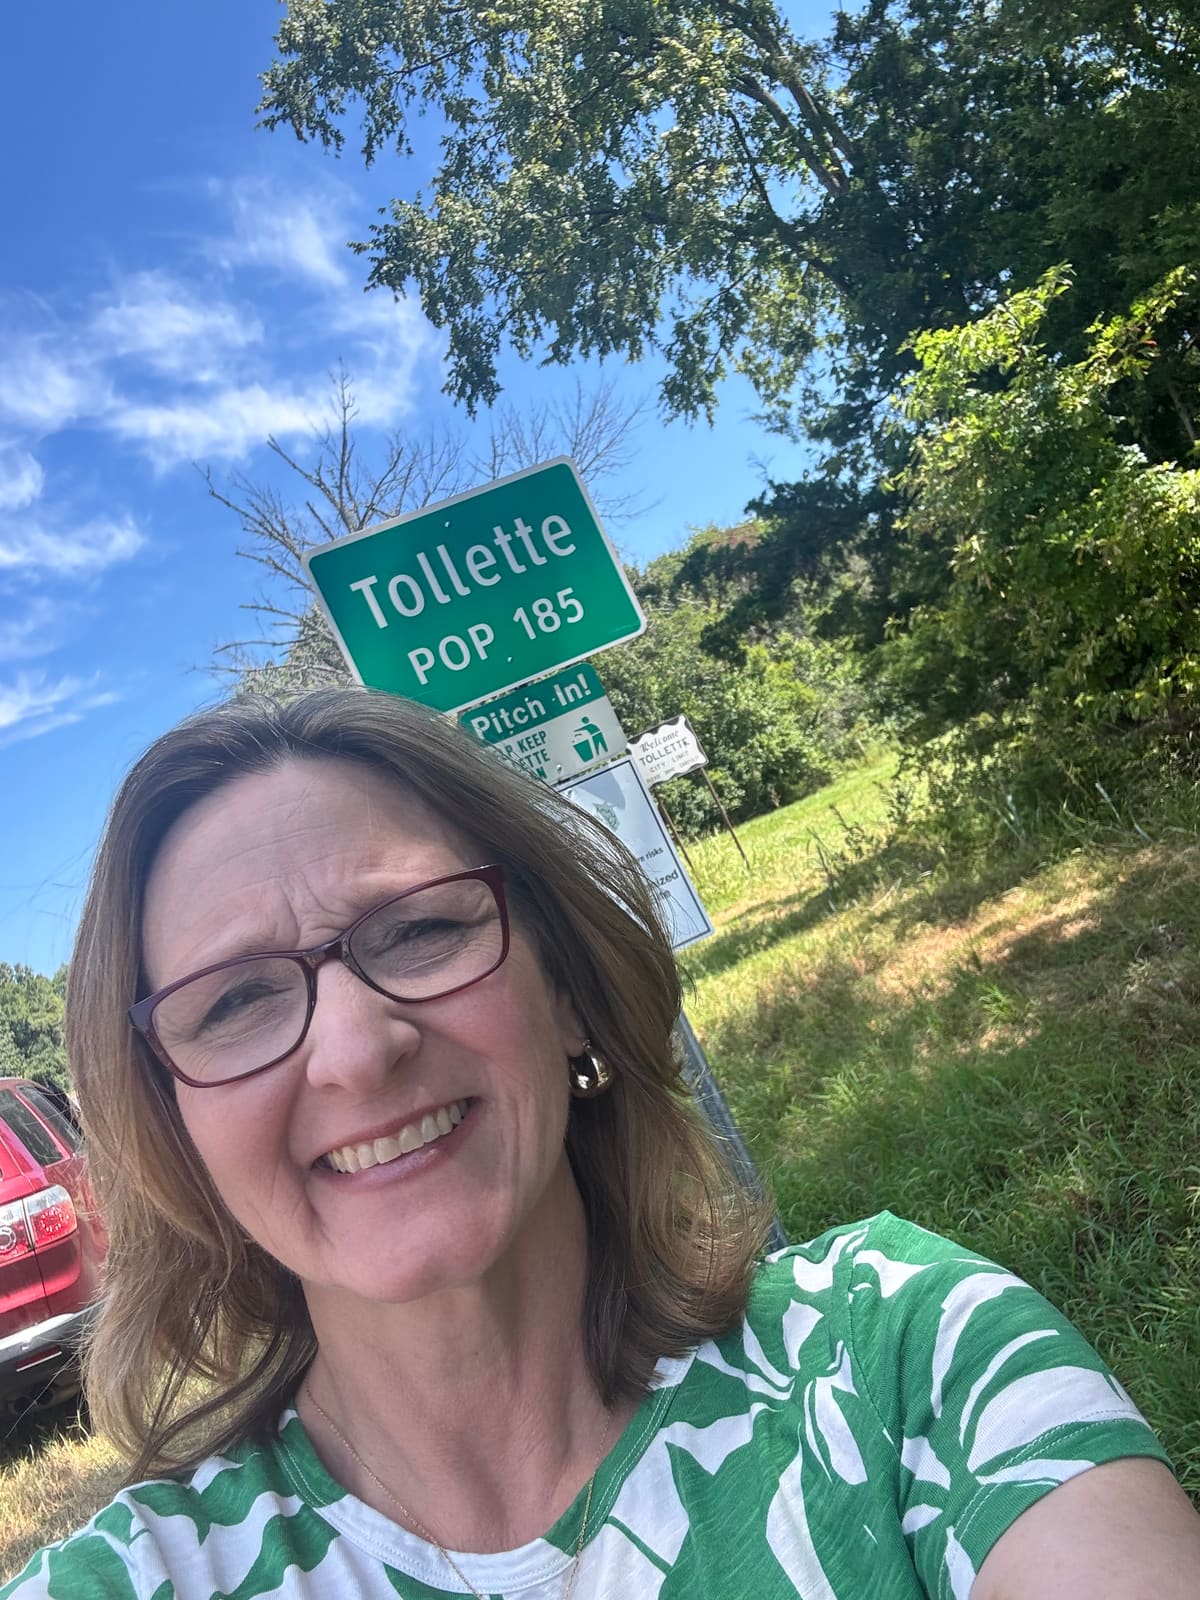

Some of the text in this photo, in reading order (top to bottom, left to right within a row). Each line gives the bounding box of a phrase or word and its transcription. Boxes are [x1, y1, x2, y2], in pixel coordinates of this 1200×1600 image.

[350, 514, 577, 629] Tollette
[407, 587, 585, 685] POP 185
[471, 673, 592, 740] Pitch In!
[517, 731, 547, 753] KEEP
[640, 730, 679, 753] Welcome
[640, 737, 690, 766] TOLLETTE
[645, 848, 664, 860] risks
